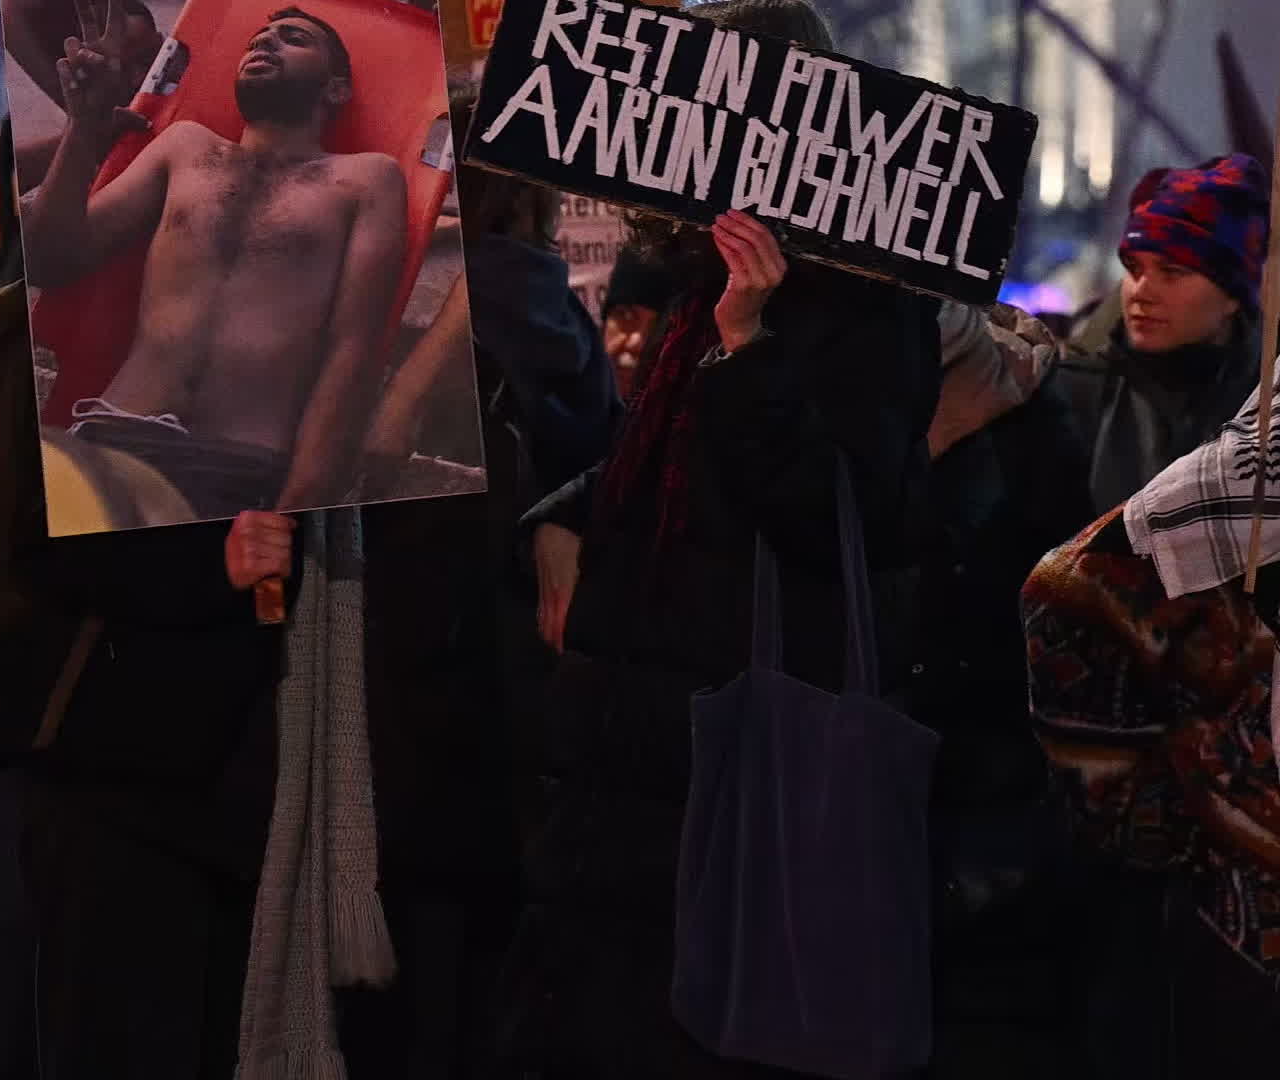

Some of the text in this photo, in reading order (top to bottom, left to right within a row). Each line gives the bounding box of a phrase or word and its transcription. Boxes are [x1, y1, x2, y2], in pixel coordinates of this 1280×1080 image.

[481, 65, 990, 280] AARON BUSHNELL
[695, 27, 759, 114] IN
[770, 46, 1004, 200] POWER
